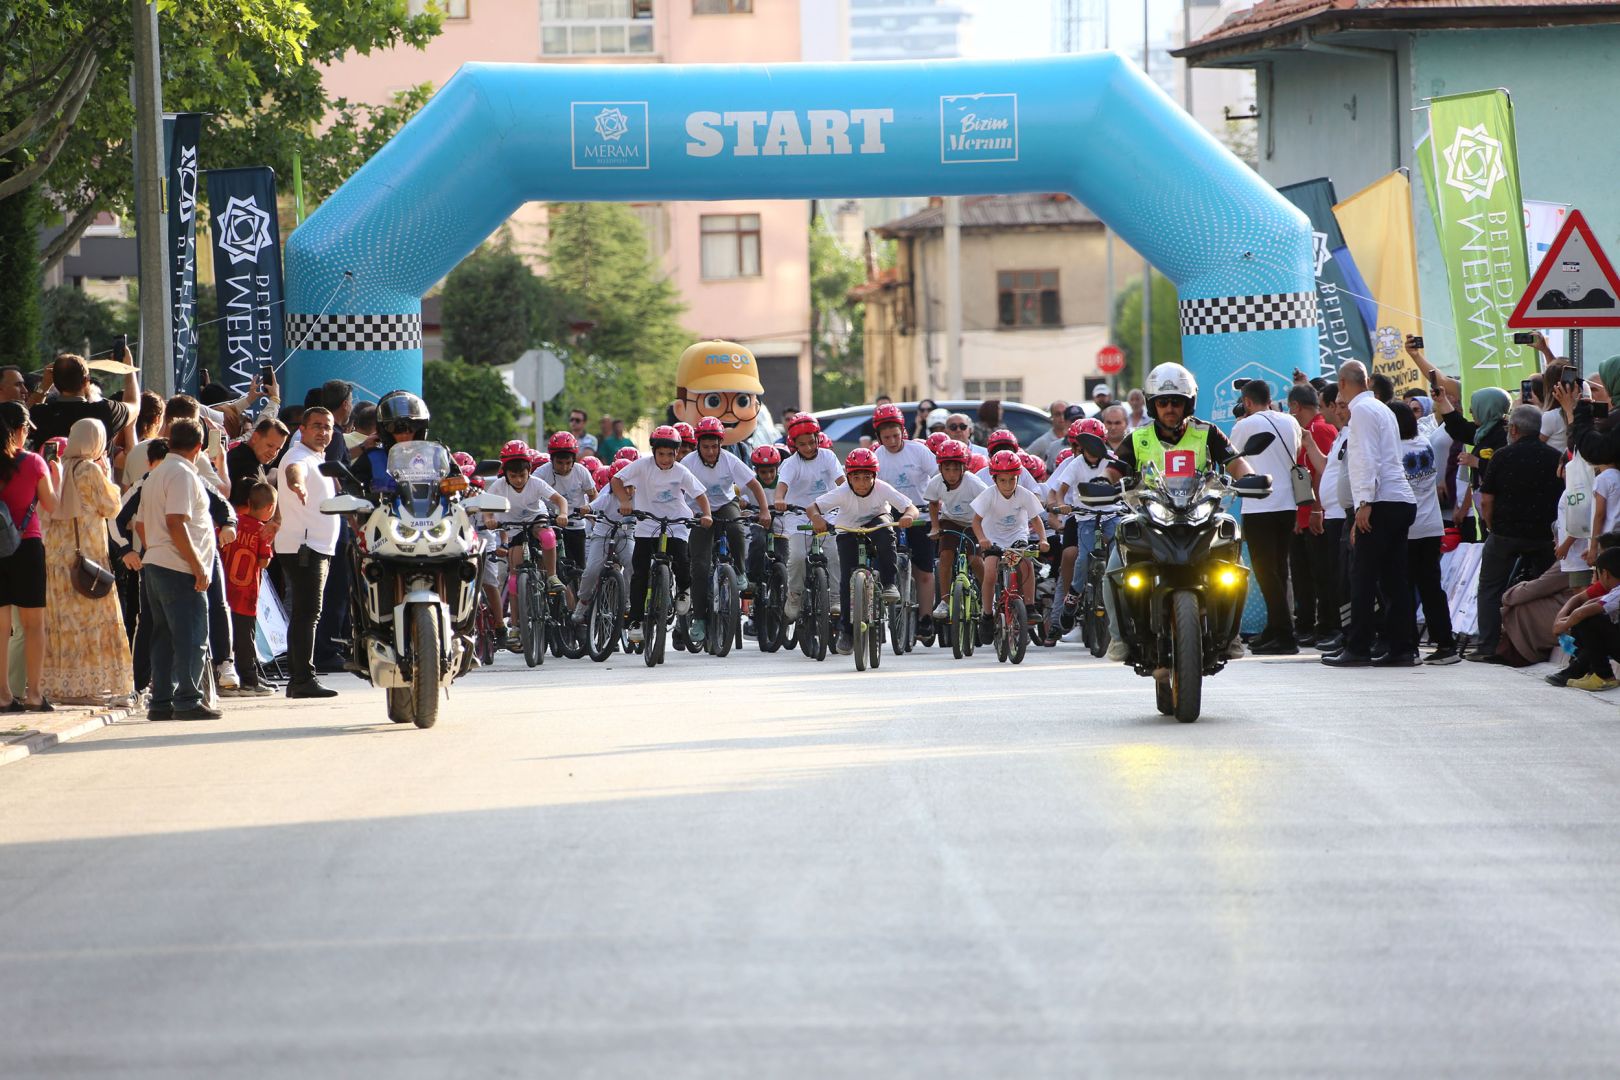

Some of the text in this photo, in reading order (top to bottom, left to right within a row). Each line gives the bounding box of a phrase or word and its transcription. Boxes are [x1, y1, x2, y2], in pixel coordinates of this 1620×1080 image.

[960, 113, 1008, 133] Bizim
[685, 108, 894, 158] START
[947, 134, 1012, 151] Meram
[584, 144, 639, 159] MERAM
[704, 353, 751, 369] mega
[1172, 455, 1187, 473] F
[410, 519, 435, 528] ZABITA
